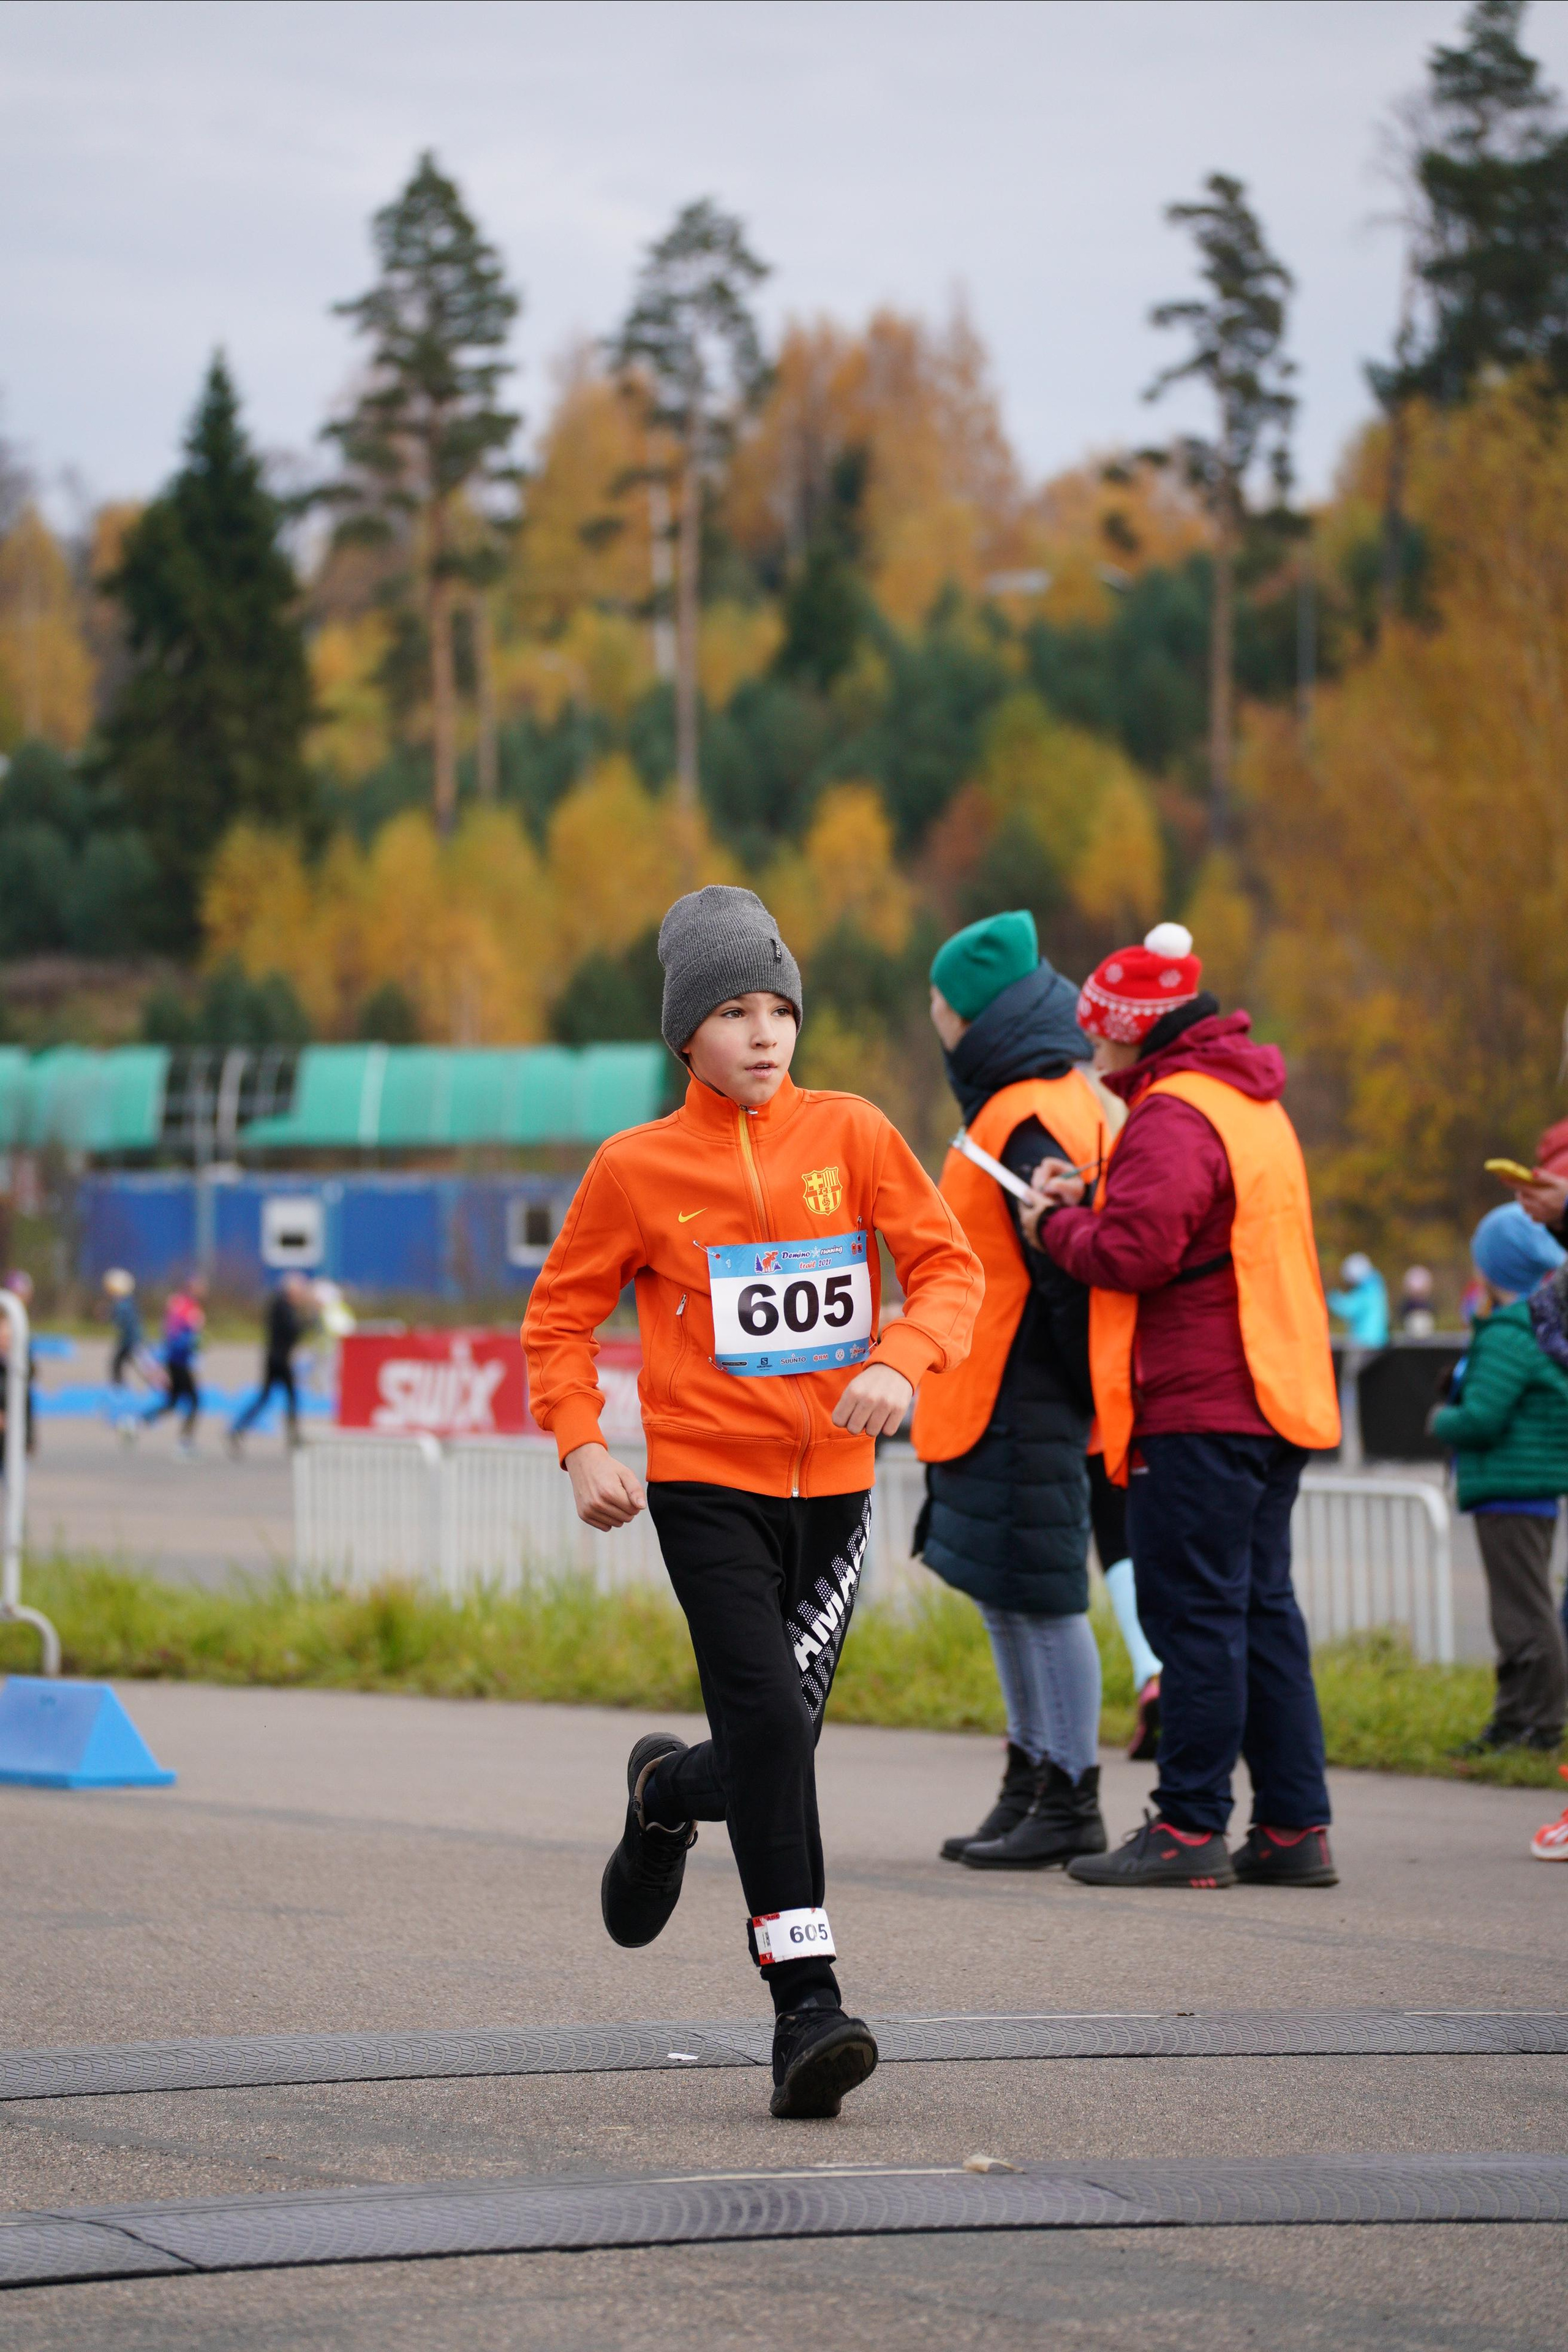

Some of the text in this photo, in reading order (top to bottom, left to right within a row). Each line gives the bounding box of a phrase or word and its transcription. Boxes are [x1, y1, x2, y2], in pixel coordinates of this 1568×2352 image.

[821, 1246, 843, 1254] running
[726, 1259, 731, 1268] 1
[799, 1258, 832, 1270] trail 2021
[737, 1274, 854, 1336] 605
[790, 1923, 828, 1943] 605
